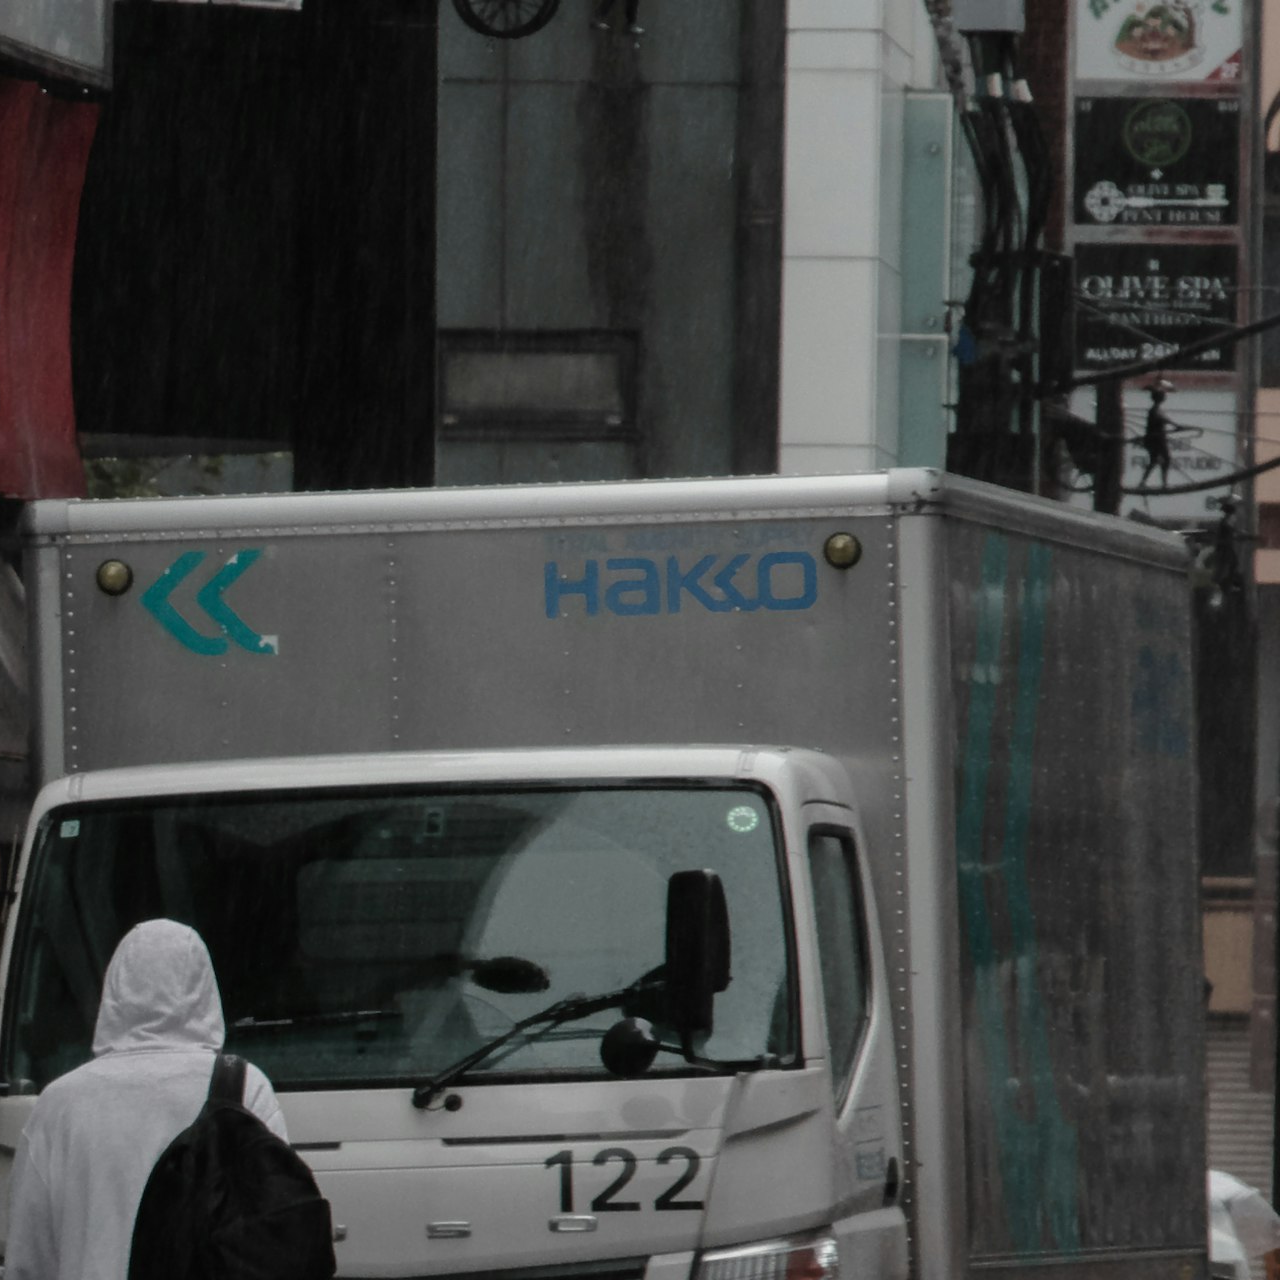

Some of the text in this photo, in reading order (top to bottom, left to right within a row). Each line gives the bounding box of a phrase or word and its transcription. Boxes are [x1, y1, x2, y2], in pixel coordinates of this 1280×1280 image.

[1081, 275, 1228, 300] OLIVE SPA
[544, 1146, 706, 1213] 122
